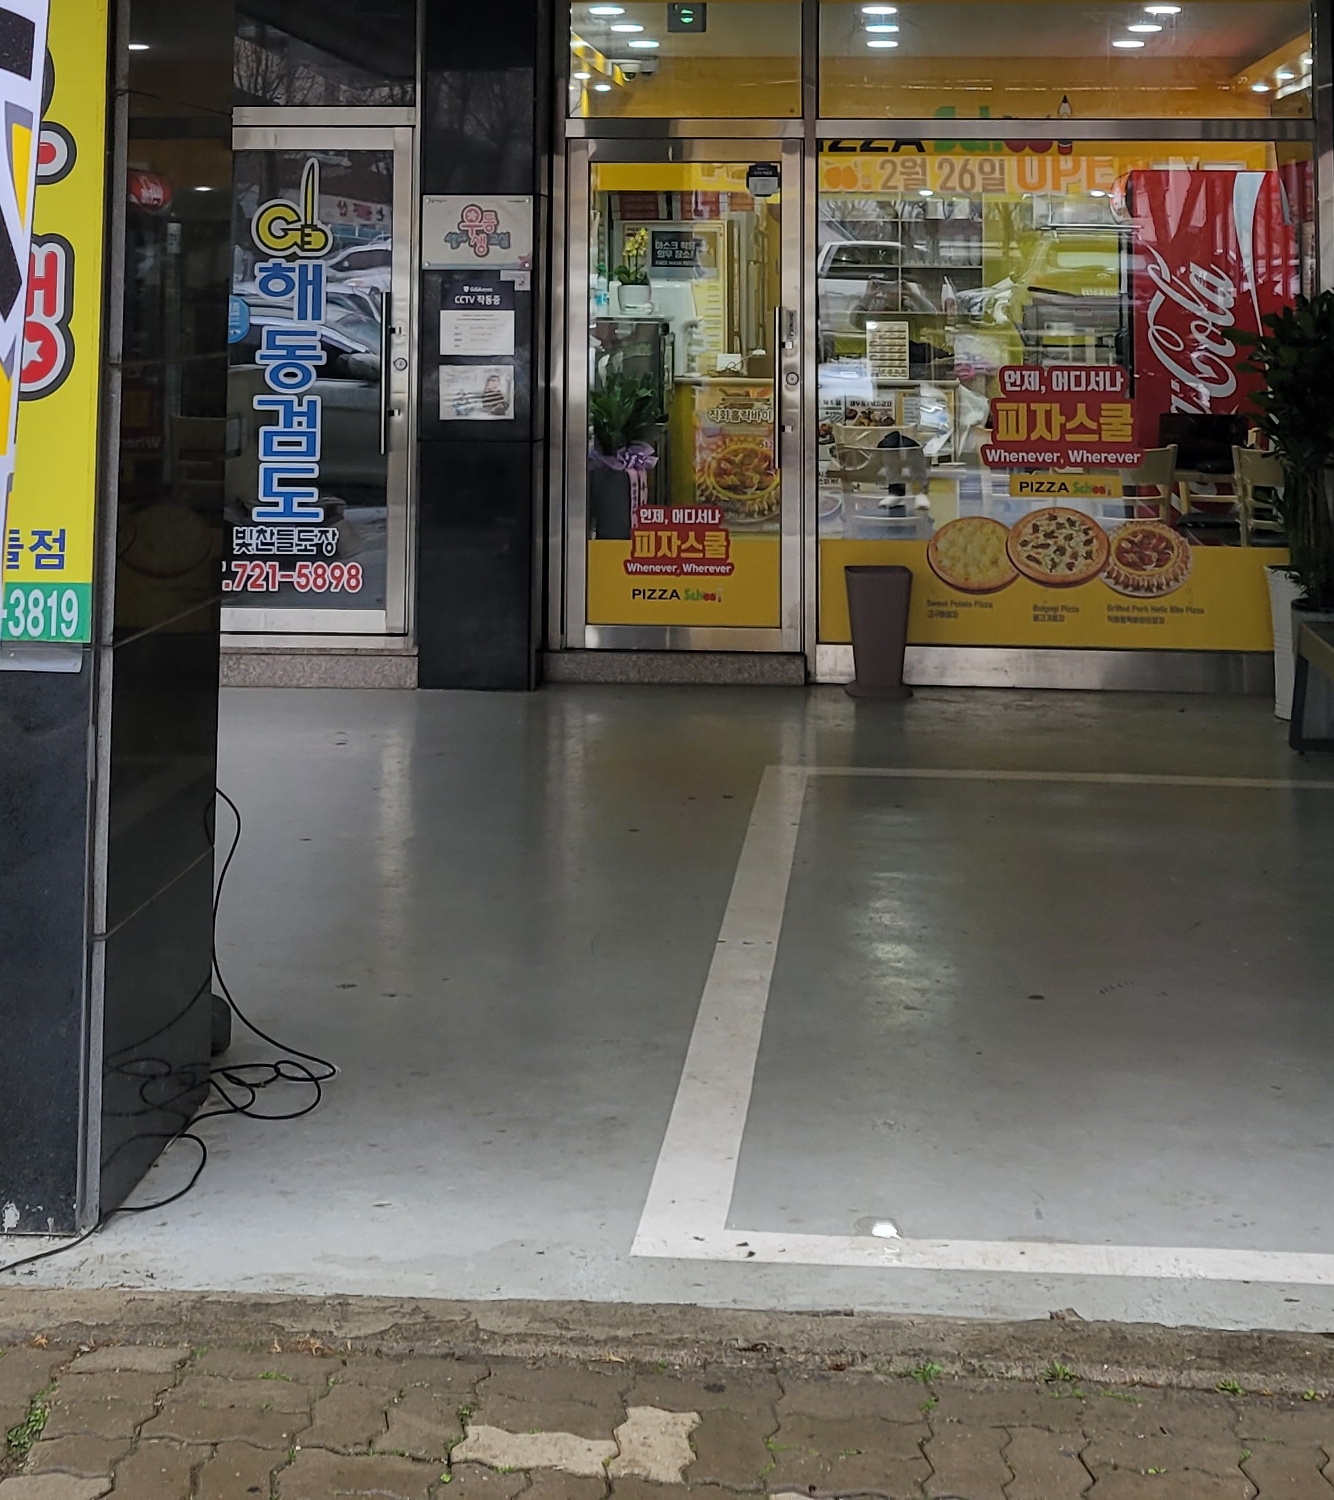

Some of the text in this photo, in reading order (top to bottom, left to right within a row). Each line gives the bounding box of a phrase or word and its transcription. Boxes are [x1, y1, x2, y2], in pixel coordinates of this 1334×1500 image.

[454, 295, 476, 305] CCTV
[1004, 370, 1124, 394] 언제, 어디서나
[254, 260, 327, 522] 해동검도
[709, 408, 773, 423] 직화홀릭바이
[995, 402, 1134, 442] 피자스쿨
[986, 448, 1141, 464] Whenever, Wherever
[1019, 479, 1112, 496] PIZZA School
[640, 508, 721, 525] 언제, 어디서나
[633, 530, 728, 559] 피자스쿨
[626, 562, 732, 574] Whenever, Wherever
[222, 561, 363, 593] .721-5898
[632, 586, 722, 603] PIZZA School
[1185, 605, 1205, 614] Pizza
